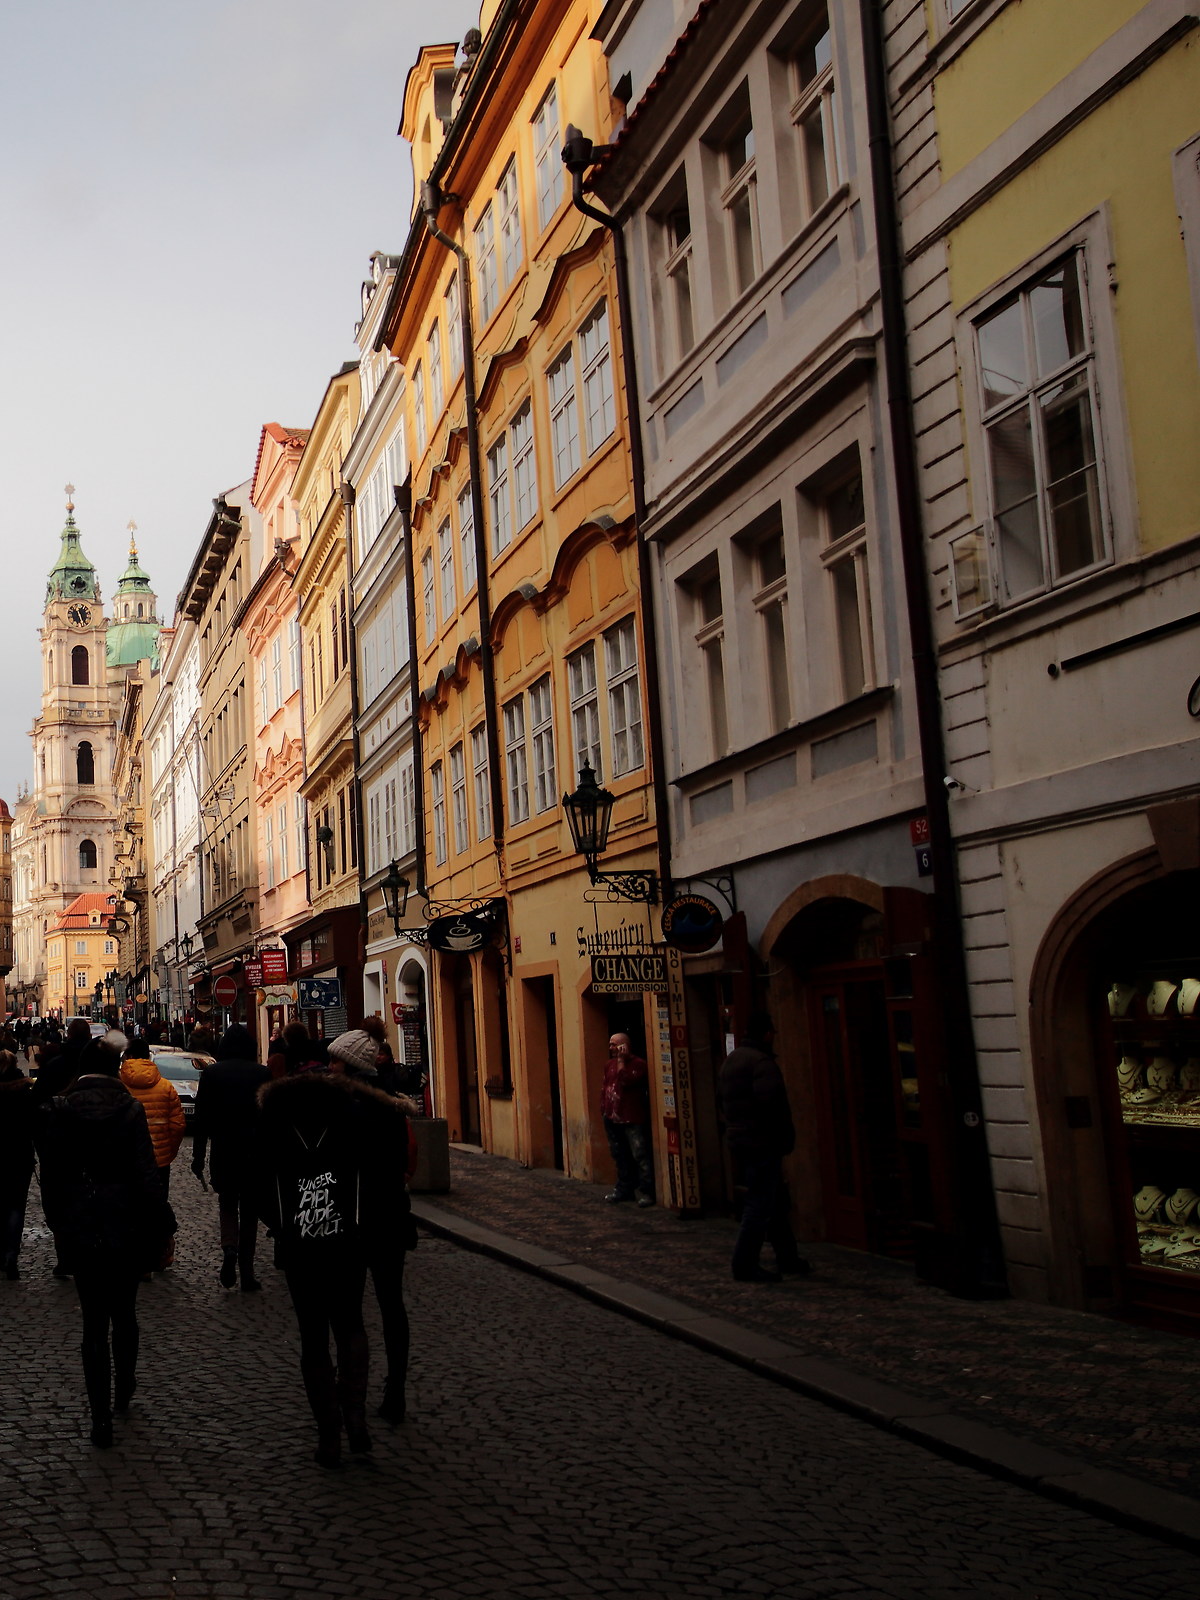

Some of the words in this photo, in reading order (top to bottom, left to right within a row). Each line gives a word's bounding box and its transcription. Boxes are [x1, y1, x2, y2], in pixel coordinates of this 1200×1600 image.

[915, 819, 928, 834] 52
[922, 852, 929, 868] 6
[672, 896, 718, 916] RESTAURACE
[670, 950, 679, 968] NO
[594, 957, 664, 982] CHANGE
[605, 984, 668, 992] COMMISSION
[672, 974, 682, 1022] LIMIT
[678, 1050, 693, 1149] COMMISSION
[686, 1156, 698, 1205] NETTO
